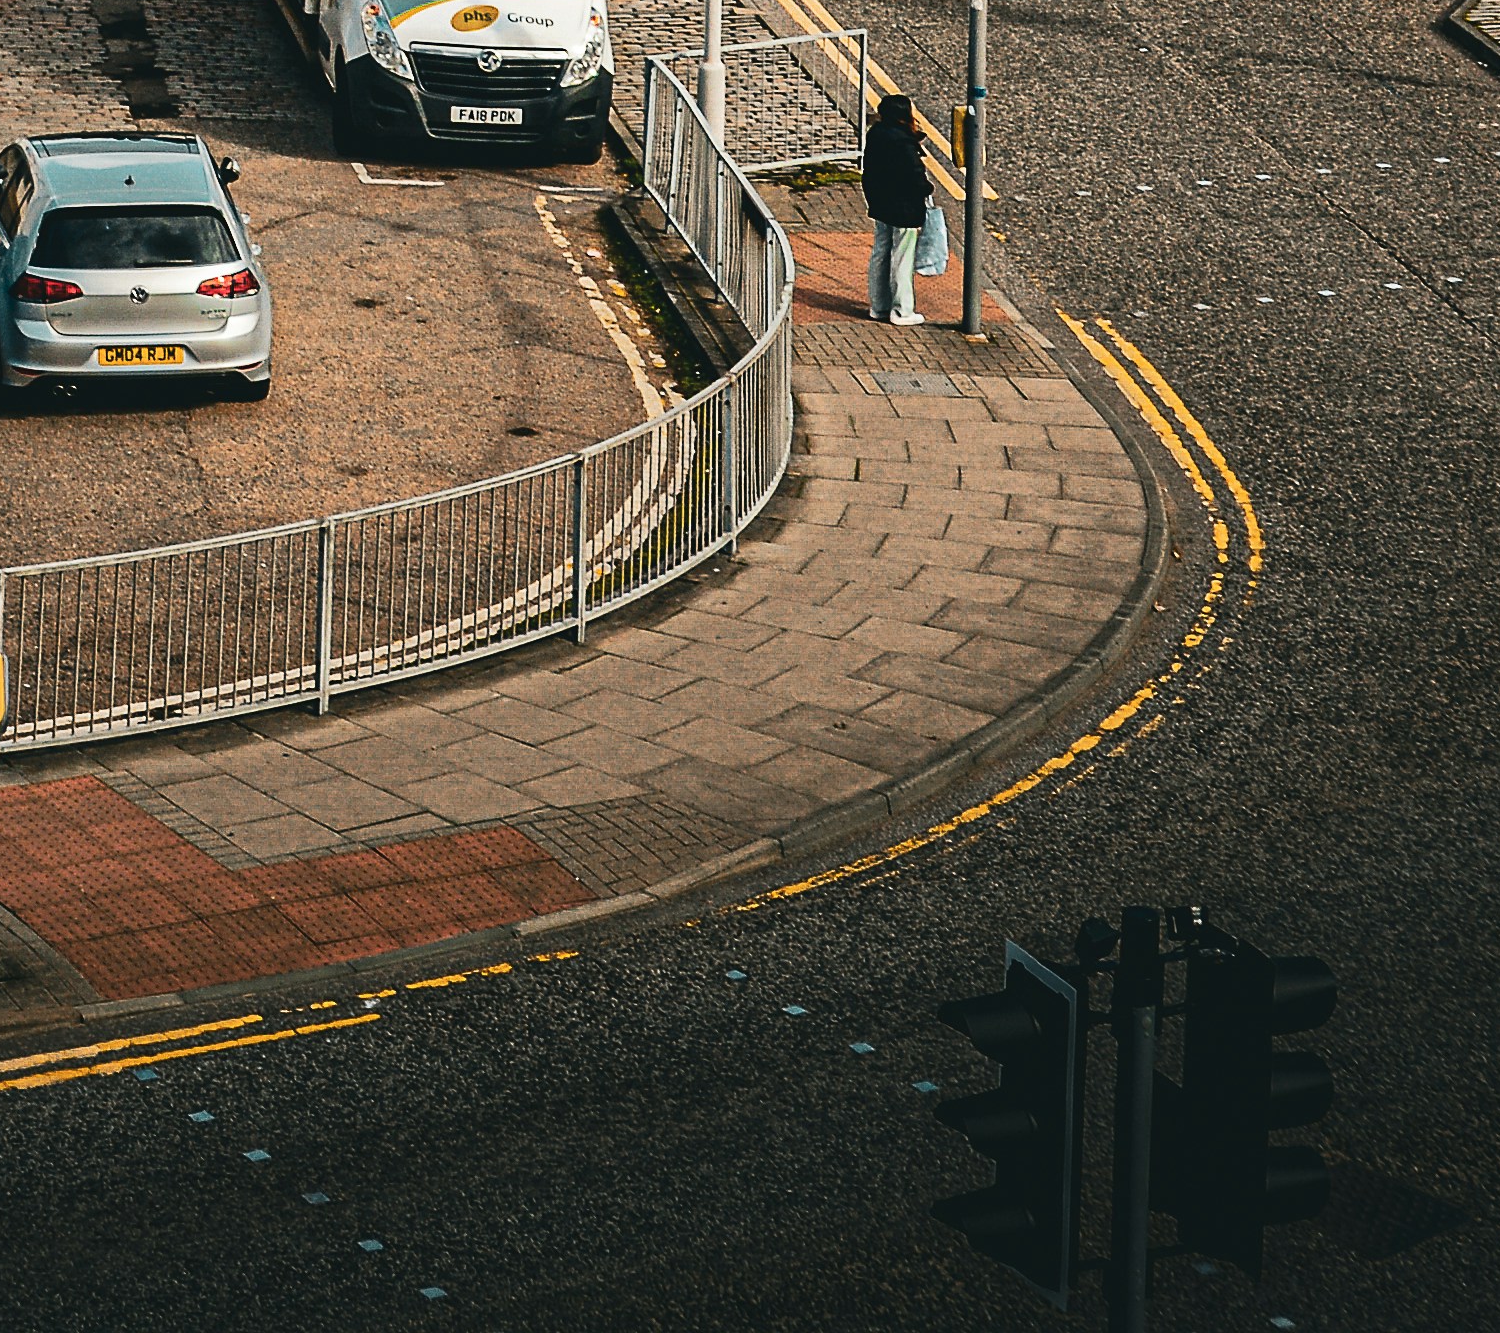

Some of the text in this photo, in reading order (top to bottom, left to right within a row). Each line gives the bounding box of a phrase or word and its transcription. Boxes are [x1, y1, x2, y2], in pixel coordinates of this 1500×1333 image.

[463, 10, 555, 28] phs Group
[459, 109, 488, 121] FA18
[105, 347, 143, 363] GM04
